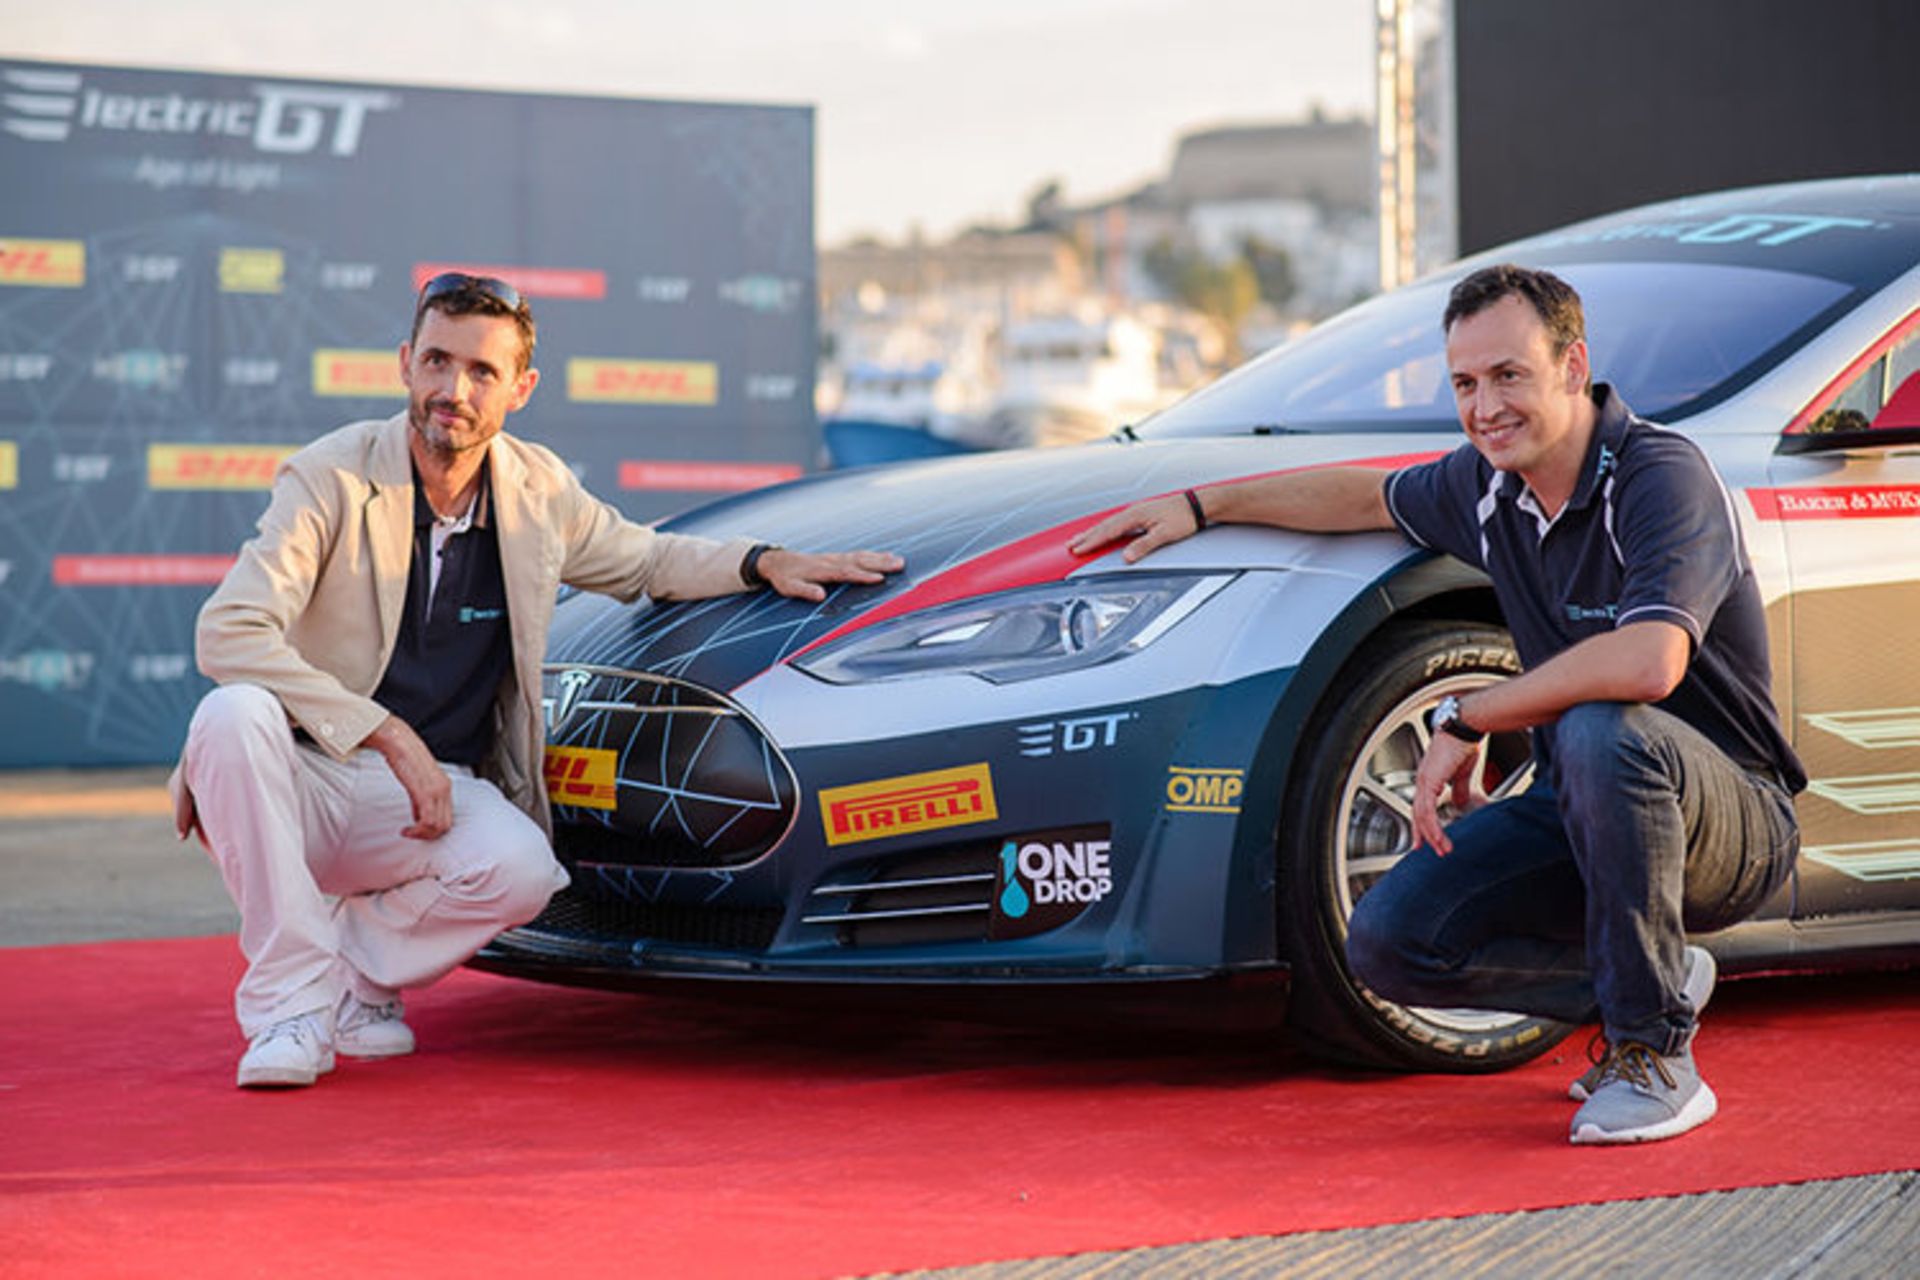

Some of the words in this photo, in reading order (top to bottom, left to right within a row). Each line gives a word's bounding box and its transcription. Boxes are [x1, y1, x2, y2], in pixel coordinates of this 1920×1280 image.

[1850, 491, 1867, 510] &
[1166, 774, 1242, 806] OMP
[829, 778, 984, 837] PIRELLI
[1017, 841, 1112, 881] ONE
[1033, 877, 1112, 904] DROP
